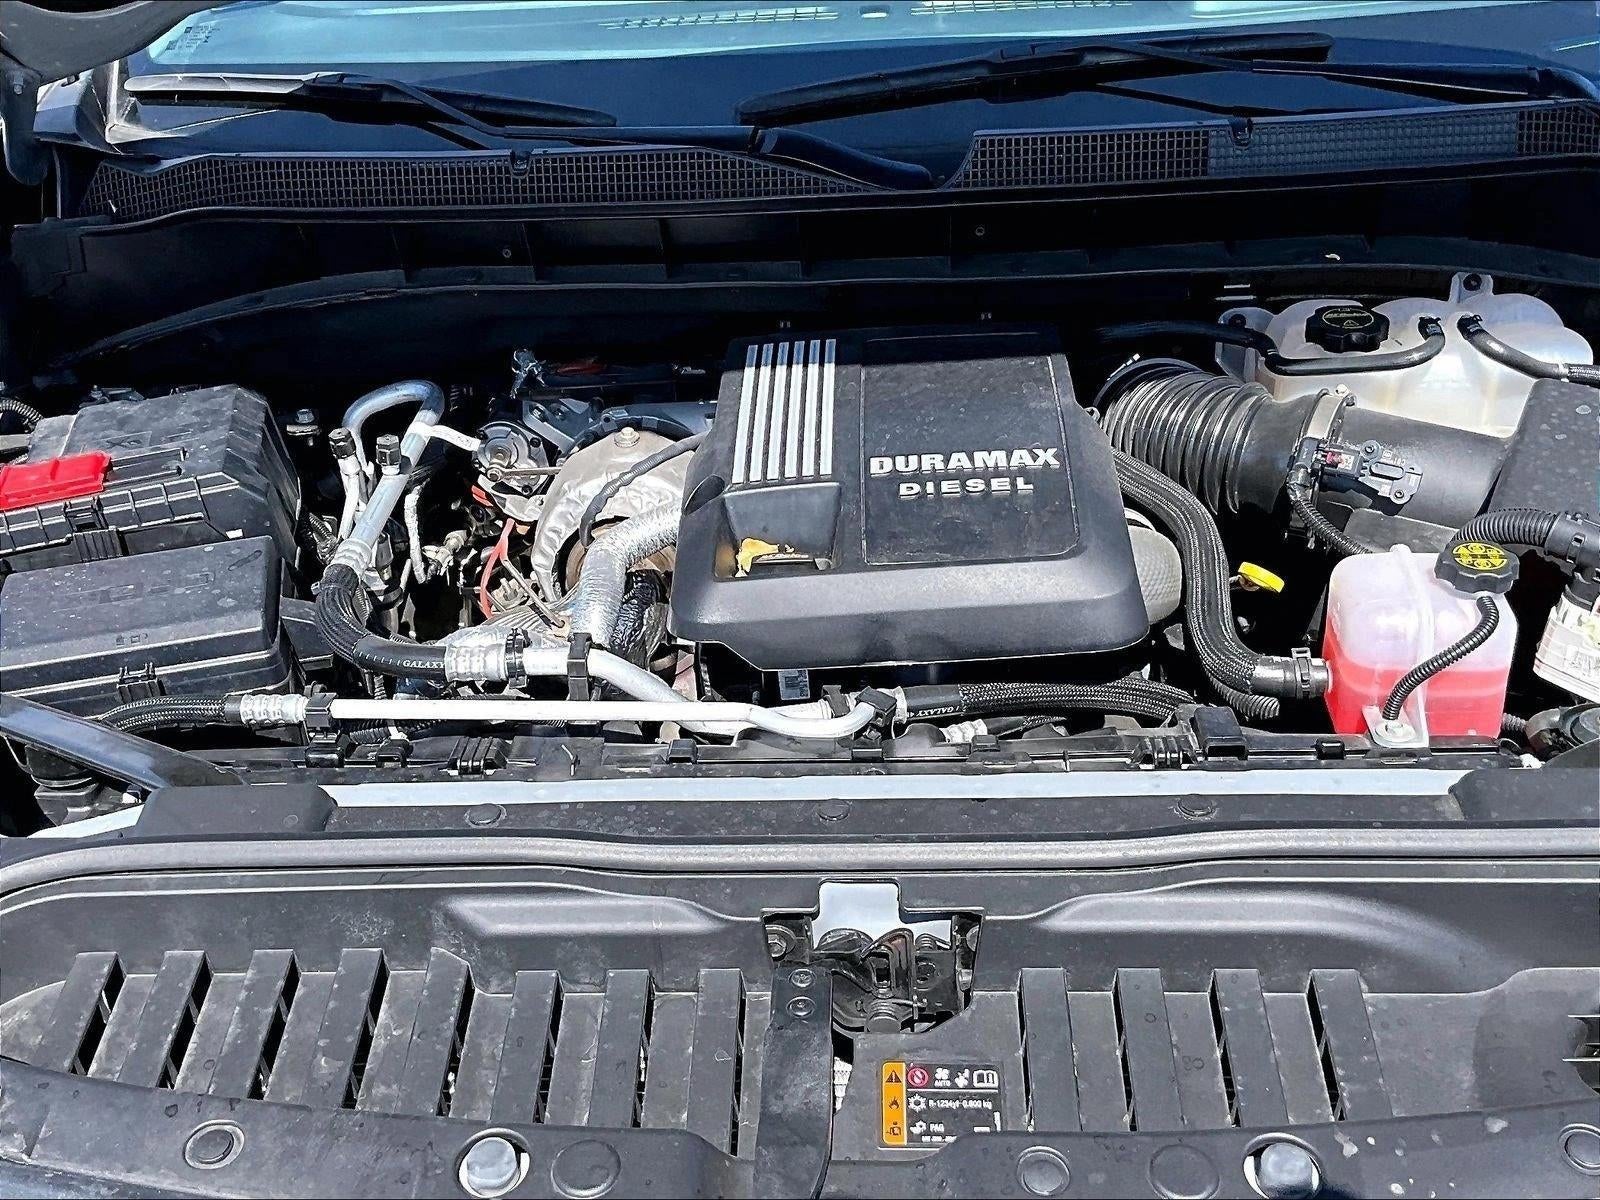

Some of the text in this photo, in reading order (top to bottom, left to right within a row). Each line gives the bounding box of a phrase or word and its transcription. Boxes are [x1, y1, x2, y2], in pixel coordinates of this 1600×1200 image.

[869, 447, 1061, 477] DURAMAX
[898, 476, 1034, 499] DIESEL
[403, 659, 445, 669] GALAXY
[916, 706, 954, 717] GALAXY
